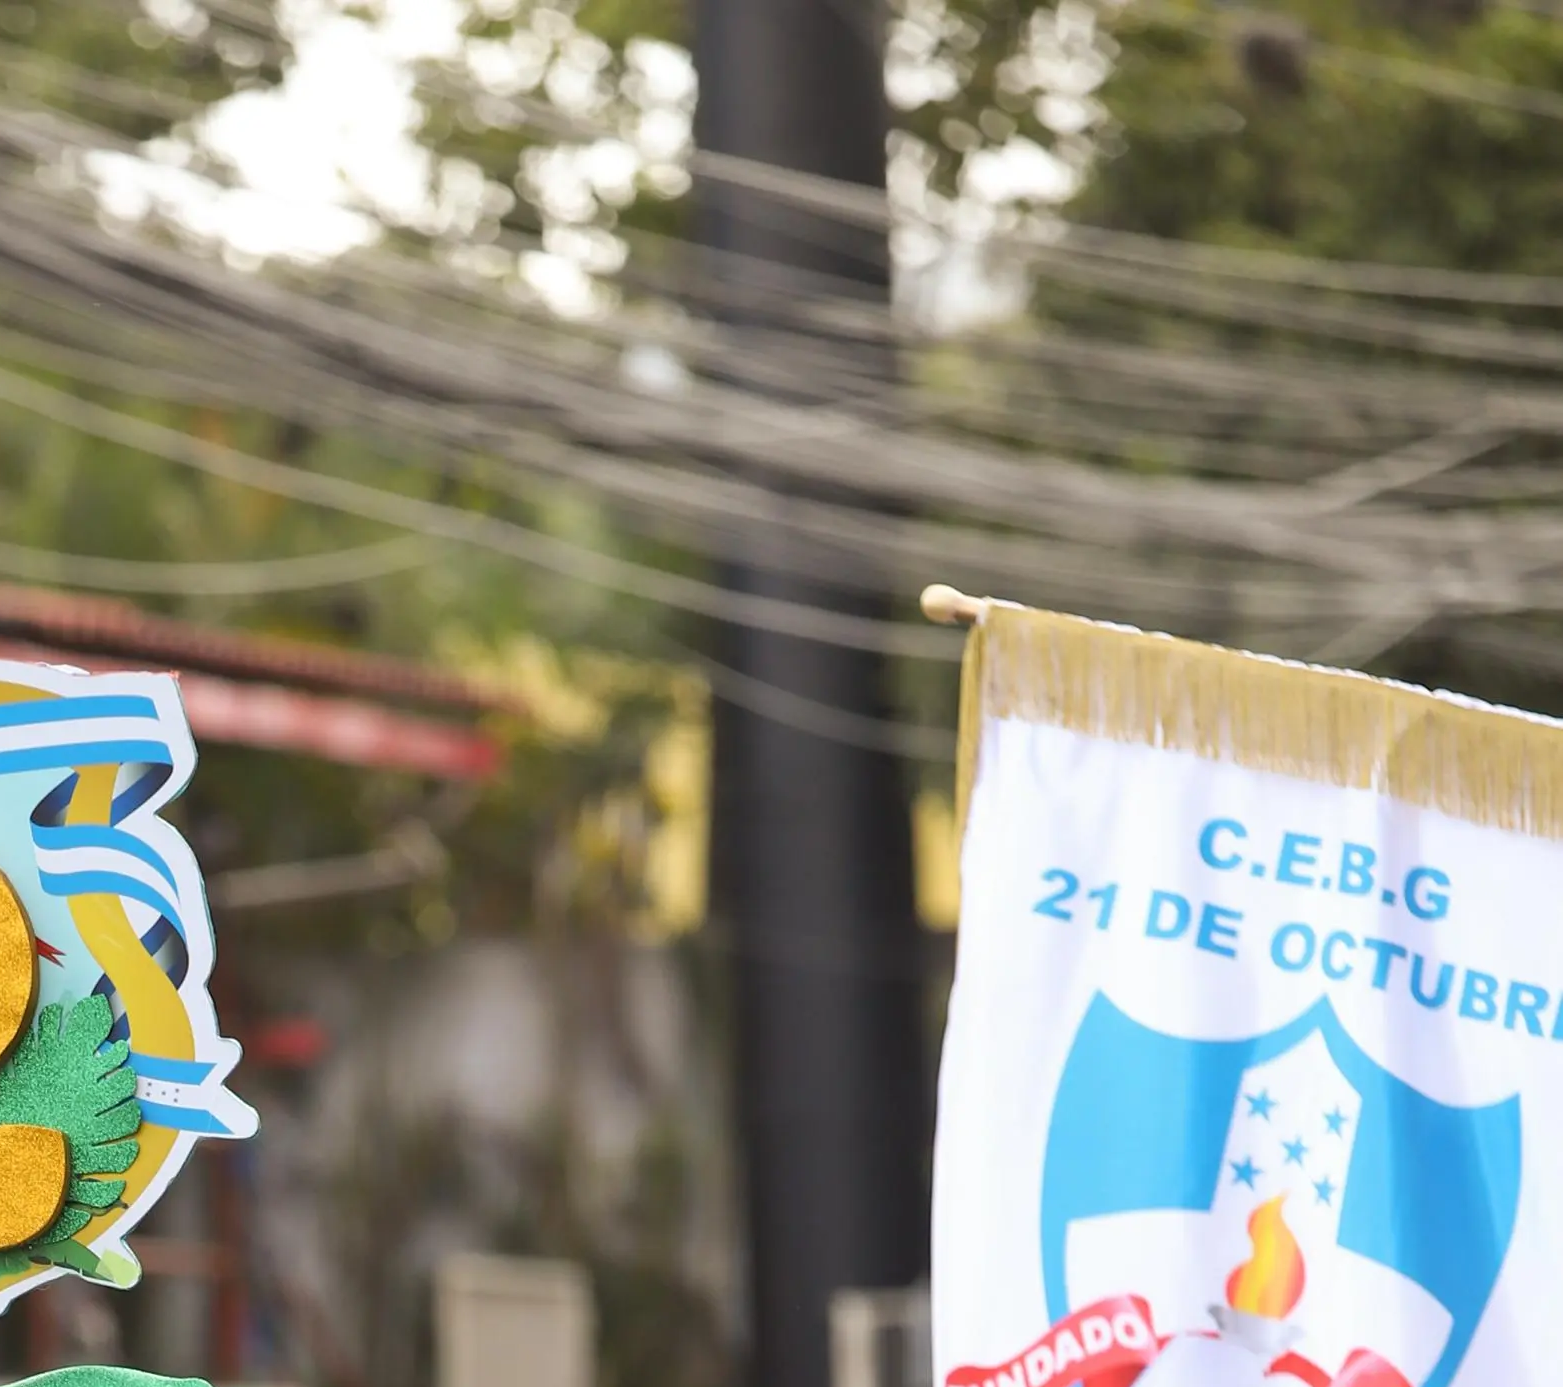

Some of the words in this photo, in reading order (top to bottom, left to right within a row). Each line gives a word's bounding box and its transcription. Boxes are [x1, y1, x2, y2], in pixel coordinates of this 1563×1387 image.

[1032, 867, 1119, 931] 21
[1144, 889, 1243, 959] DE
[1198, 818, 1452, 921] C.E.B.G
